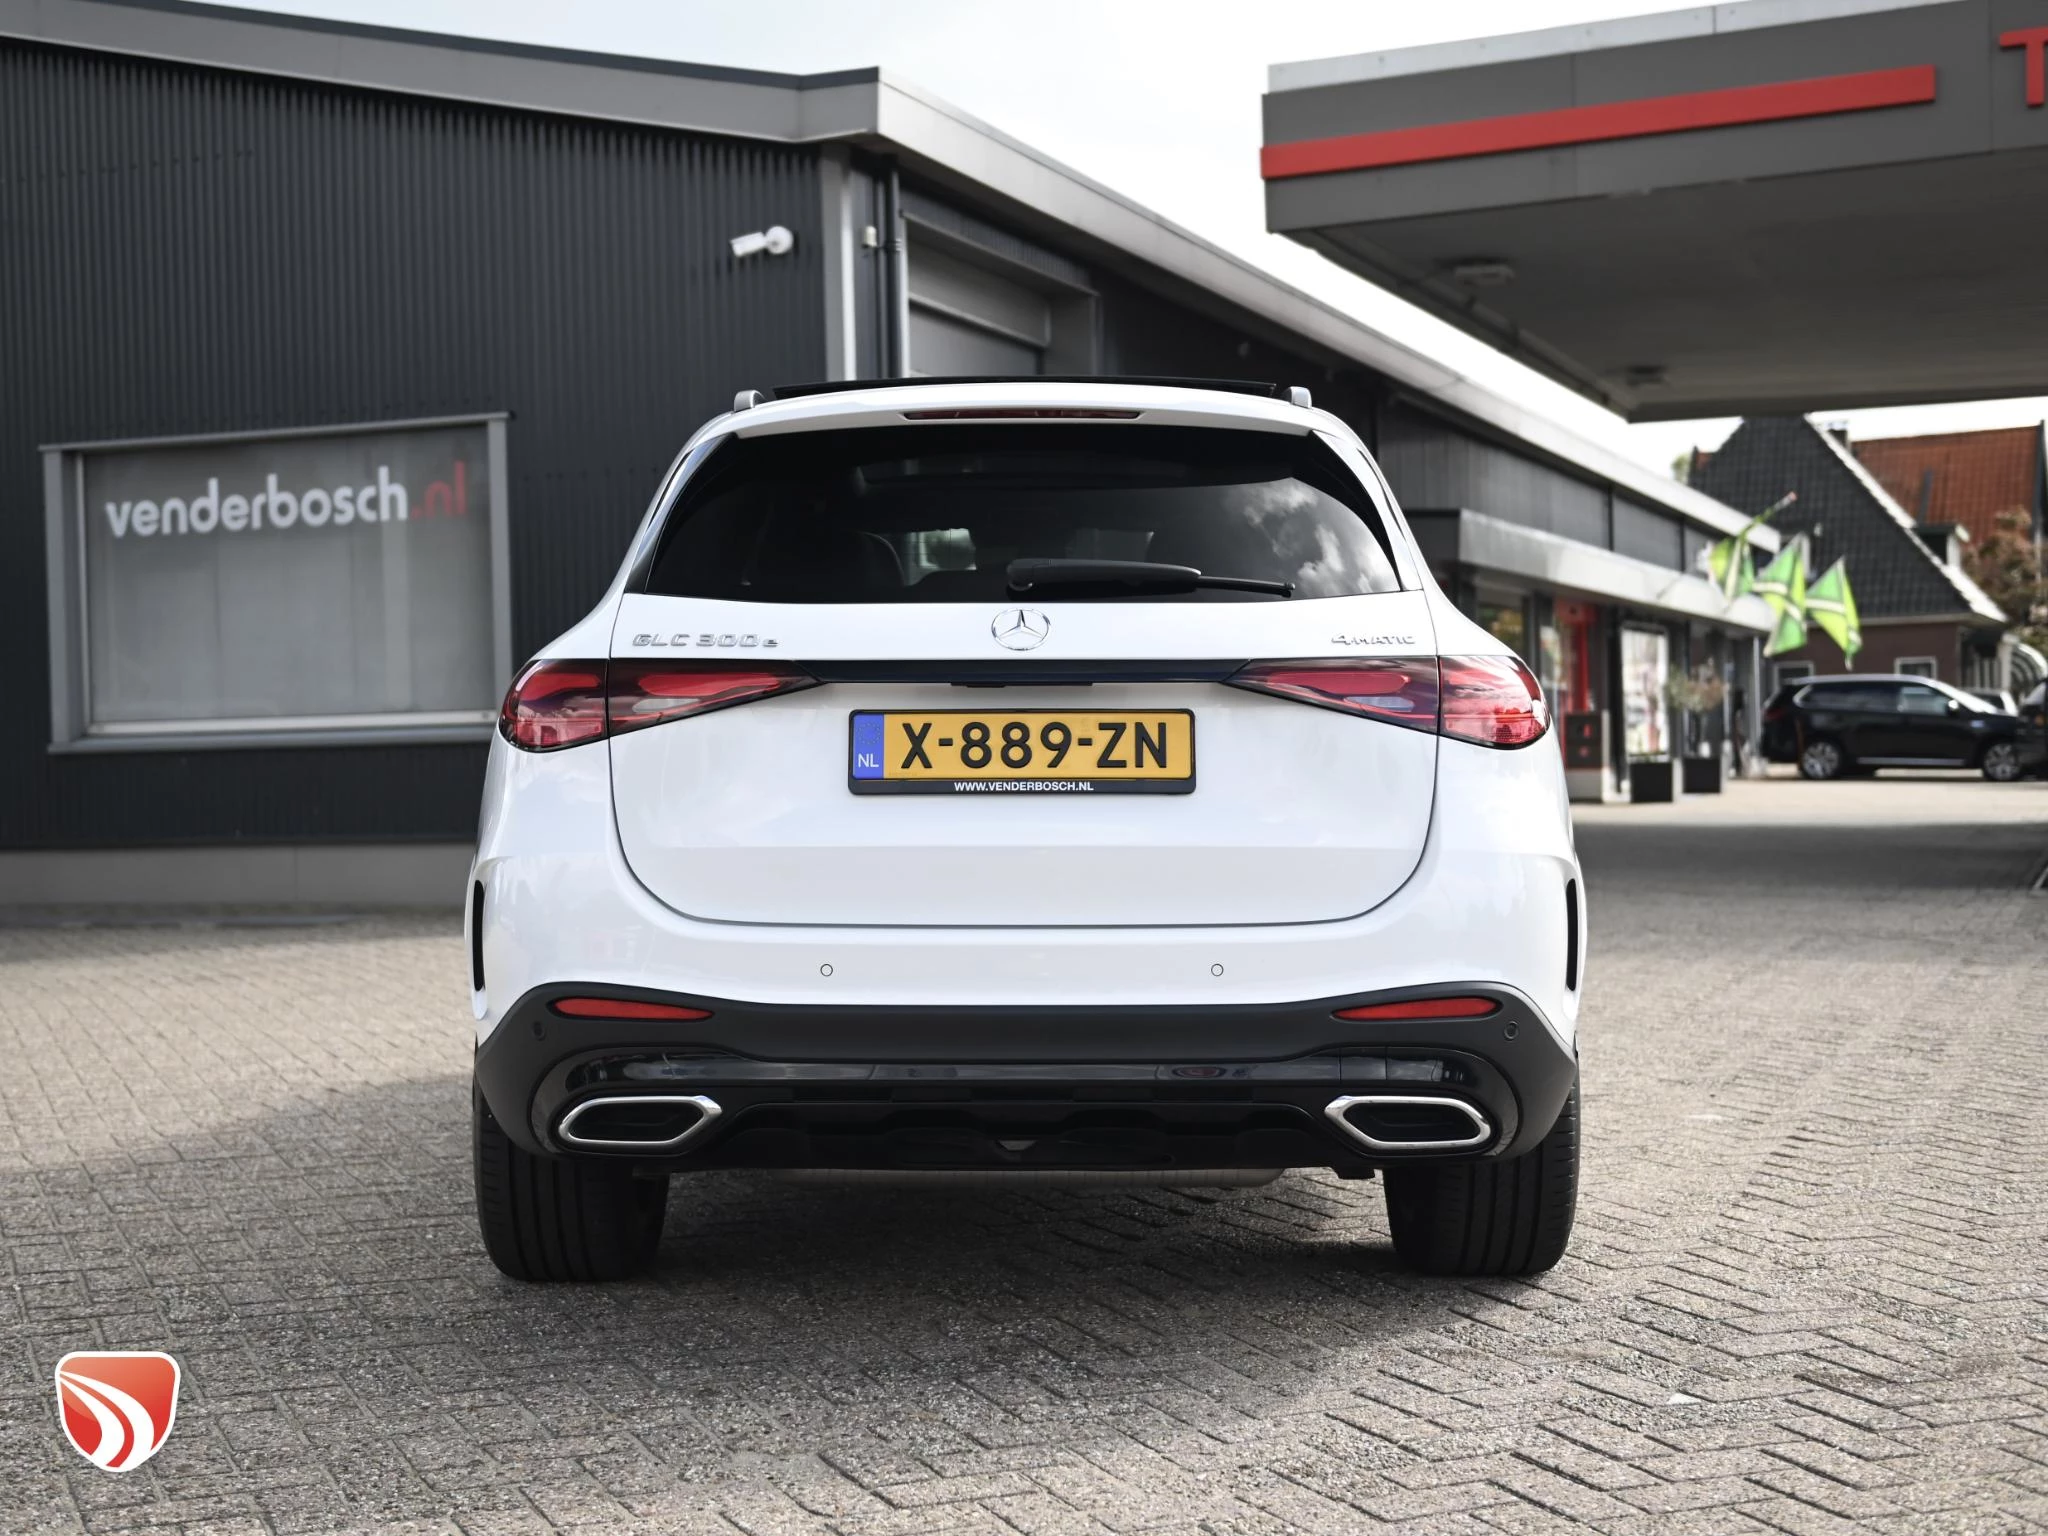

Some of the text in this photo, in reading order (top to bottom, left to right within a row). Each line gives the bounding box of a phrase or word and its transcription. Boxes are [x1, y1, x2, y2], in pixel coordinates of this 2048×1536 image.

[105, 460, 467, 538] venderbosch.nl
[632, 633, 779, 648] GLC 300e
[1331, 635, 1416, 646] 4MATIC
[900, 721, 1167, 769] X-889-ZN
[857, 753, 880, 768] NL
[953, 781, 1095, 791] WWW.VENDERBOSCH.NL
